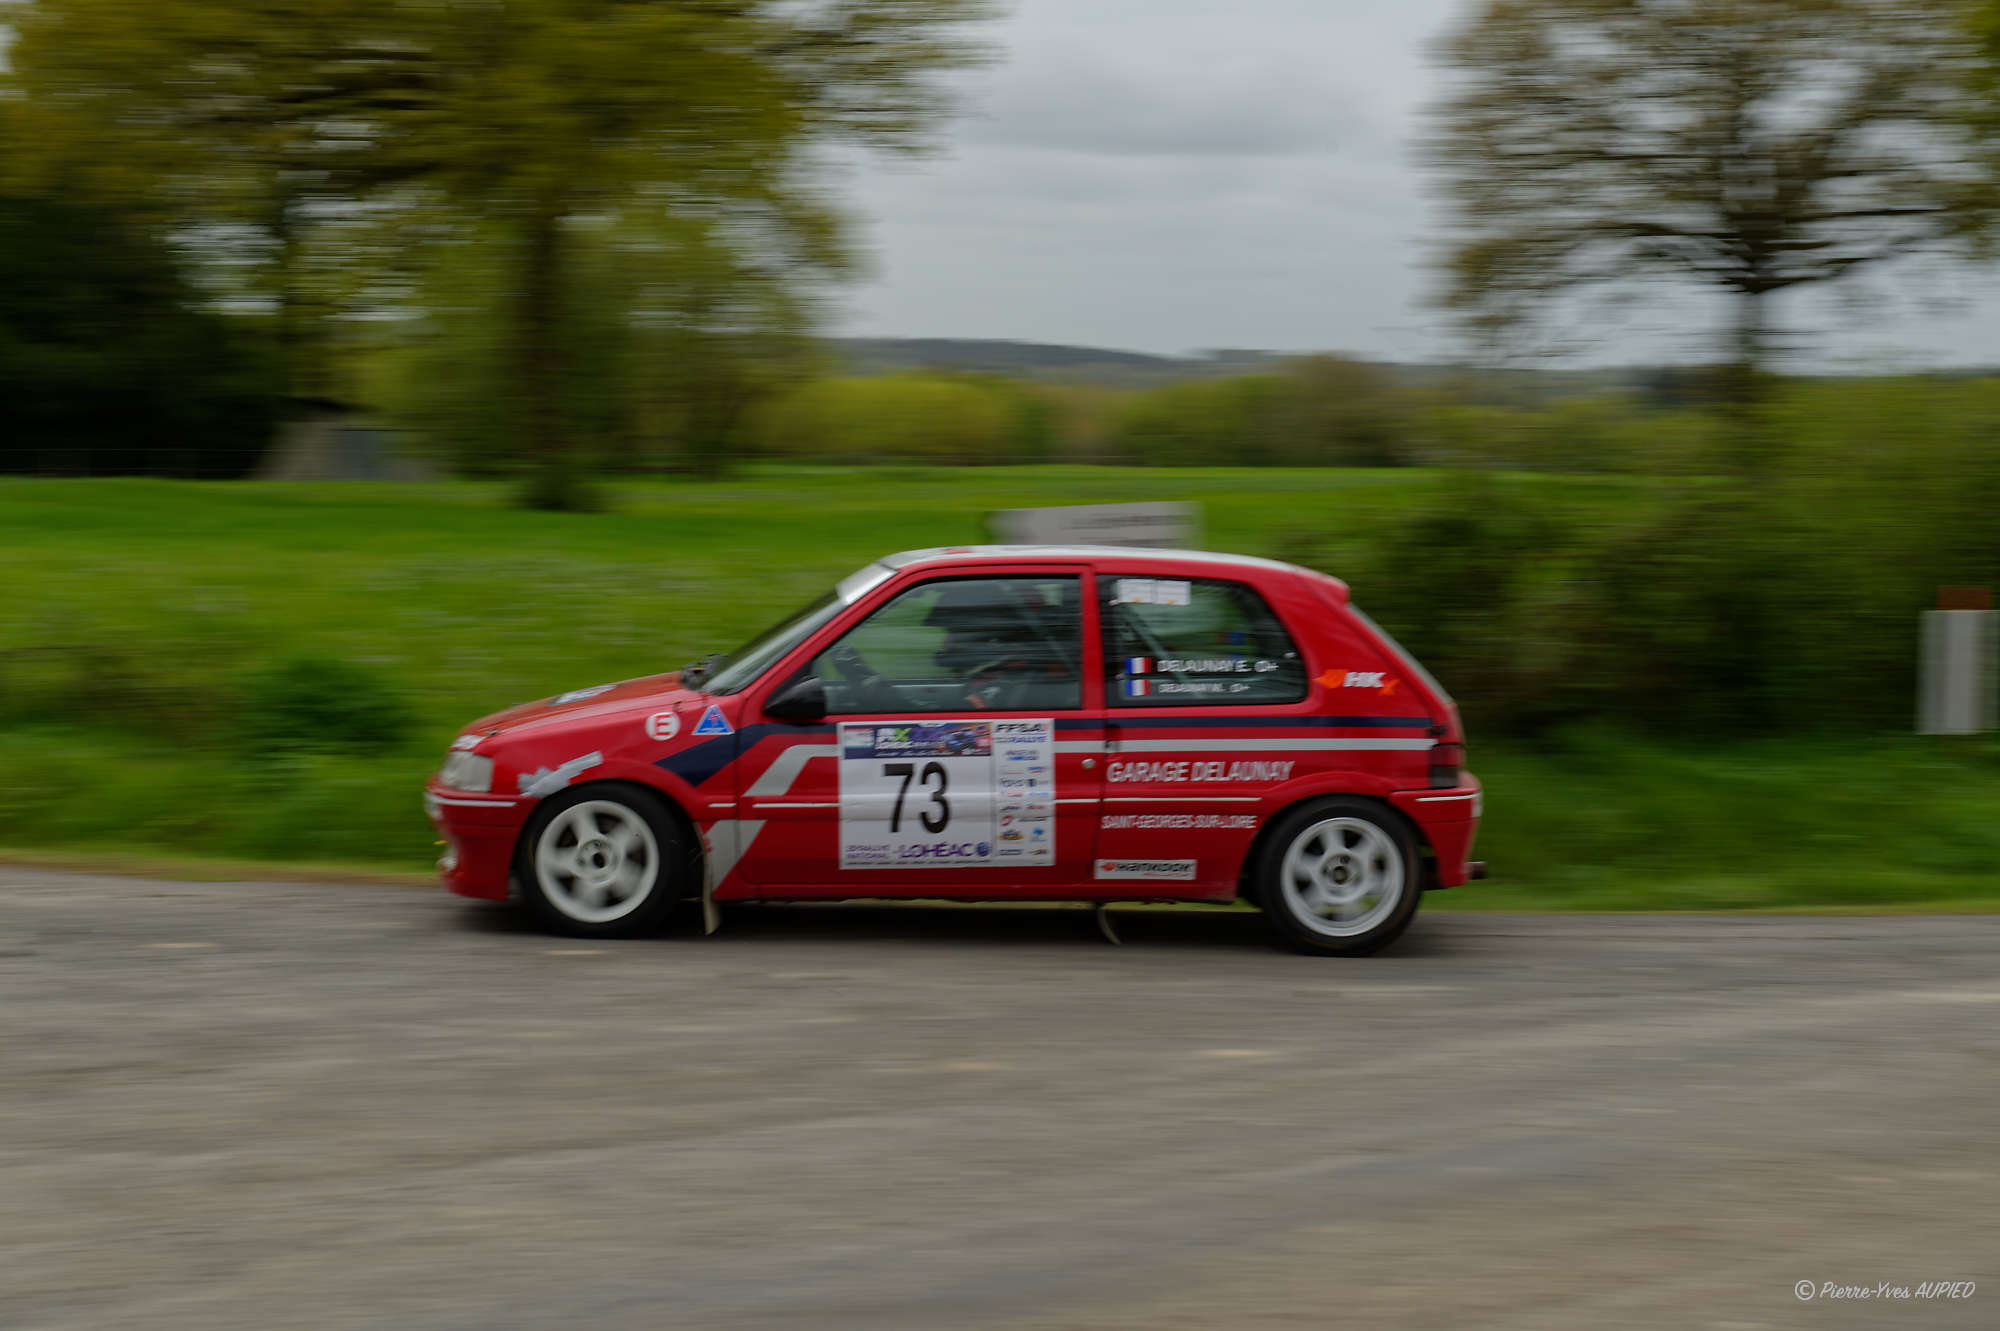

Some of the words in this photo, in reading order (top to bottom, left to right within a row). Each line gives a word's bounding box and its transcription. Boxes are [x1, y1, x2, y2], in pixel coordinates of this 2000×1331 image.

[1106, 761, 1191, 782] GARAGE
[1189, 760, 1295, 782] DELAUNAY
[883, 761, 950, 834] 73
